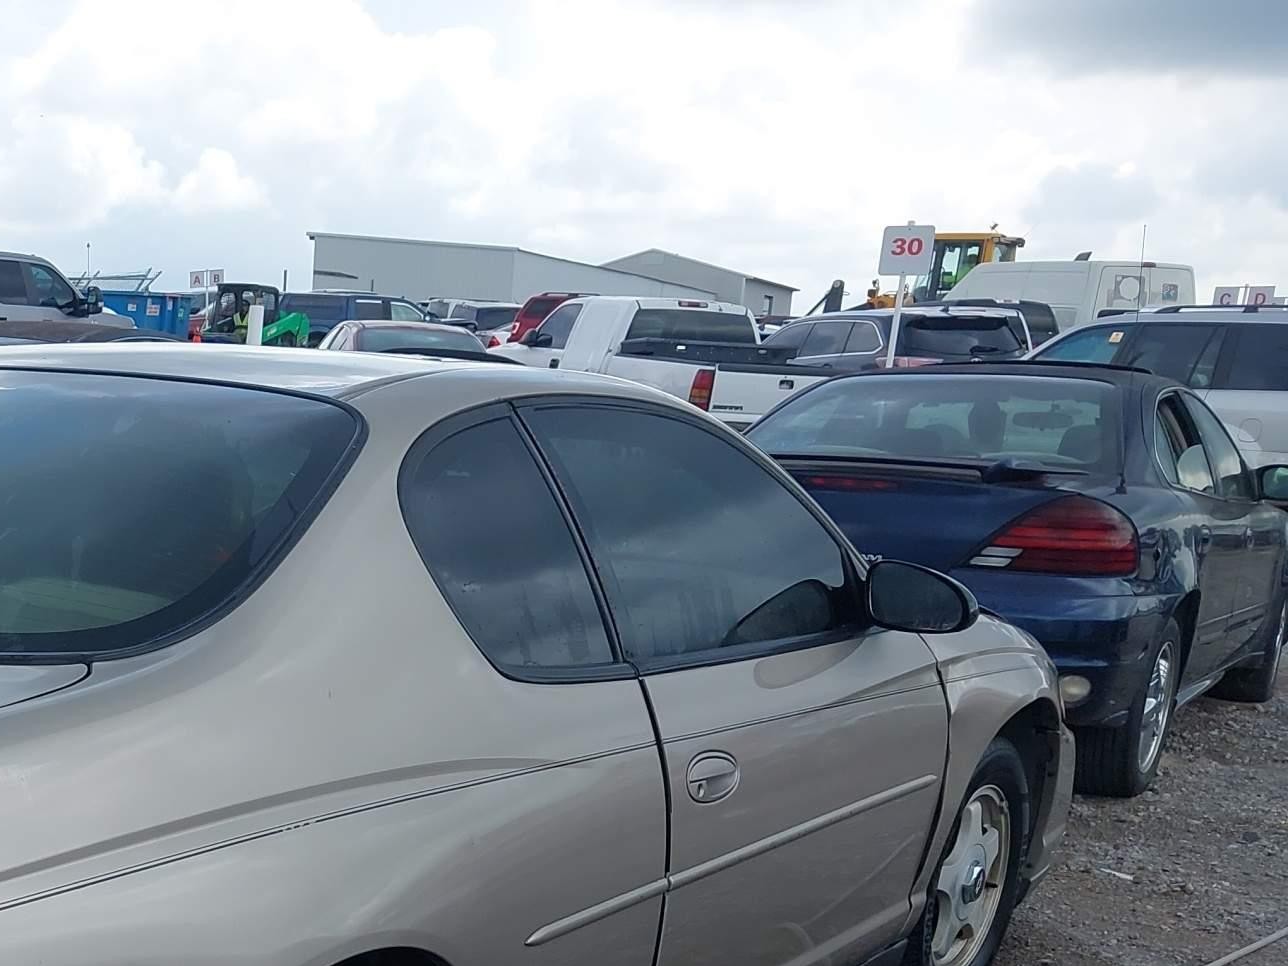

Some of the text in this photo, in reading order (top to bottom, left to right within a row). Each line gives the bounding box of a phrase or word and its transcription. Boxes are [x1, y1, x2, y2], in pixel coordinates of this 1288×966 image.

[891, 237, 923, 256] 30
[193, 275, 201, 285] A
[213, 273, 220, 283] B
[1219, 292, 1231, 305] C
[1254, 292, 1267, 305] D
